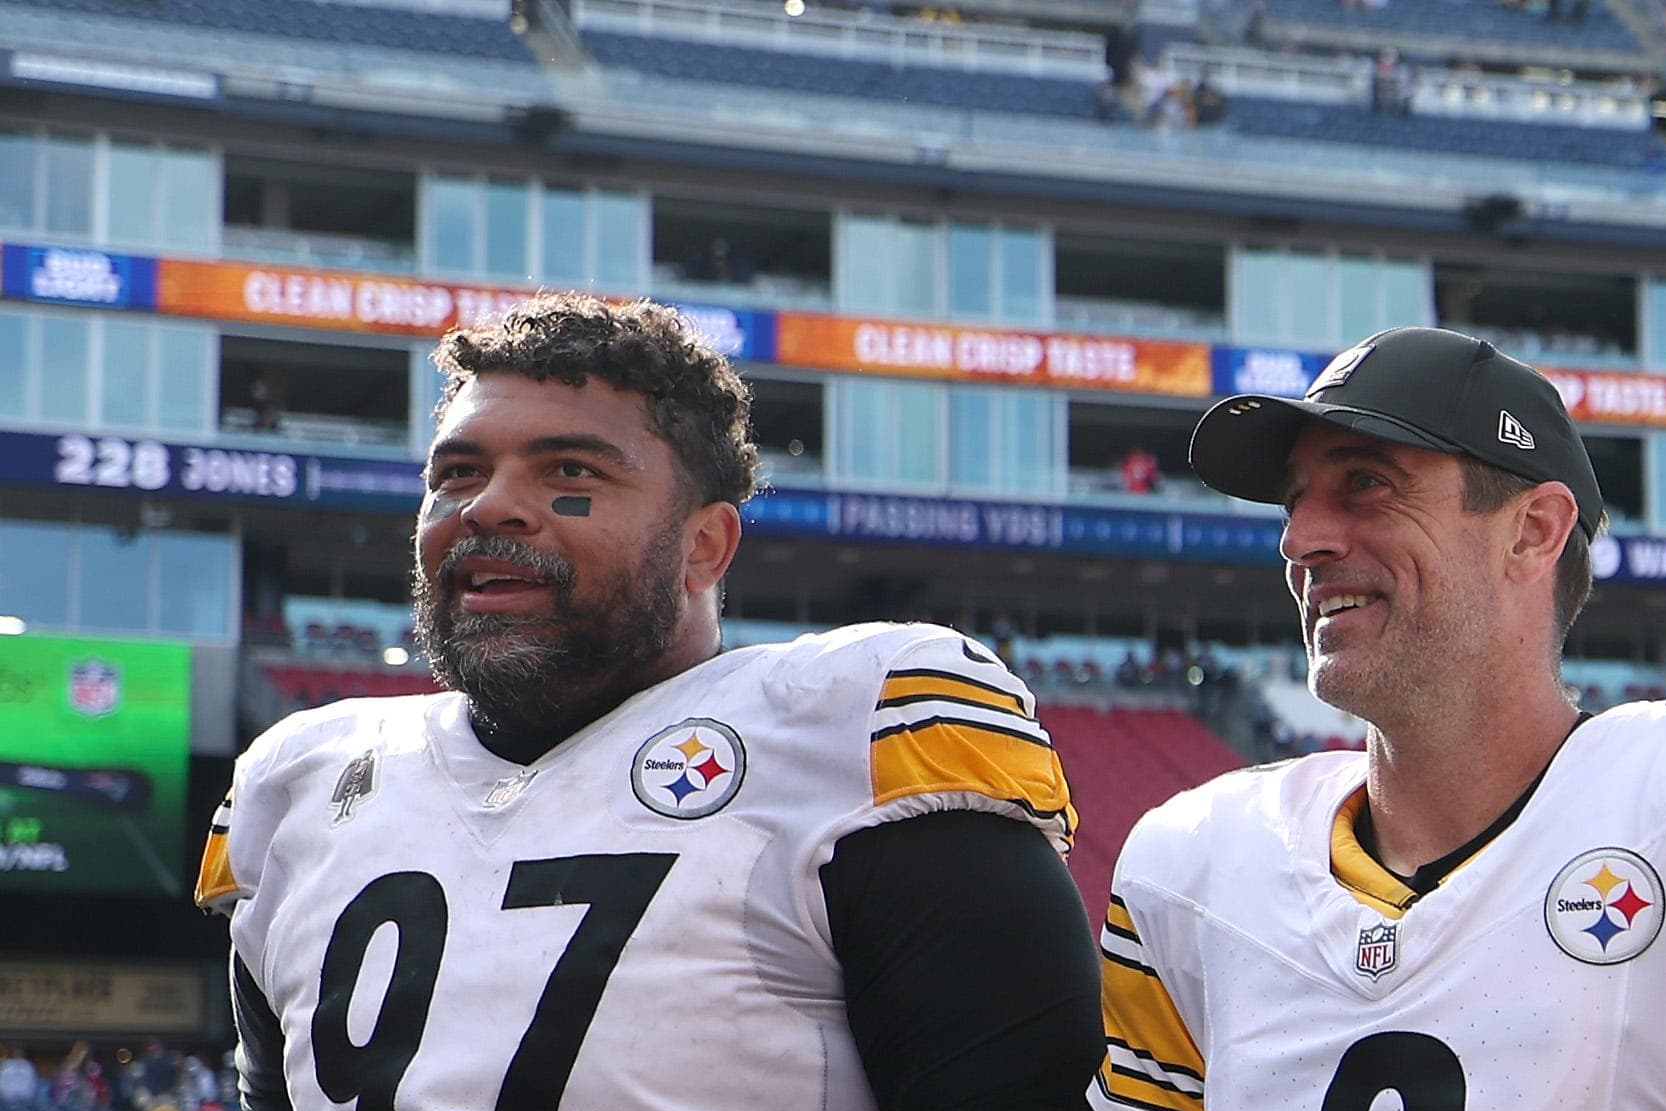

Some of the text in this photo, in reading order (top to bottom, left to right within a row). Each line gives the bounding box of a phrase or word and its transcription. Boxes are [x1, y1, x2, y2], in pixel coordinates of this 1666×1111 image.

[243, 270, 353, 319] CLEAN
[355, 280, 454, 329] CRISP
[854, 322, 1136, 382] CLEAN CRISP TASTE
[181, 447, 297, 498] JONES
[842, 496, 979, 543] PASSING
[644, 758, 685, 771] Steelers
[1557, 898, 1603, 912] Steelers
[1360, 944, 1392, 969] NFL
